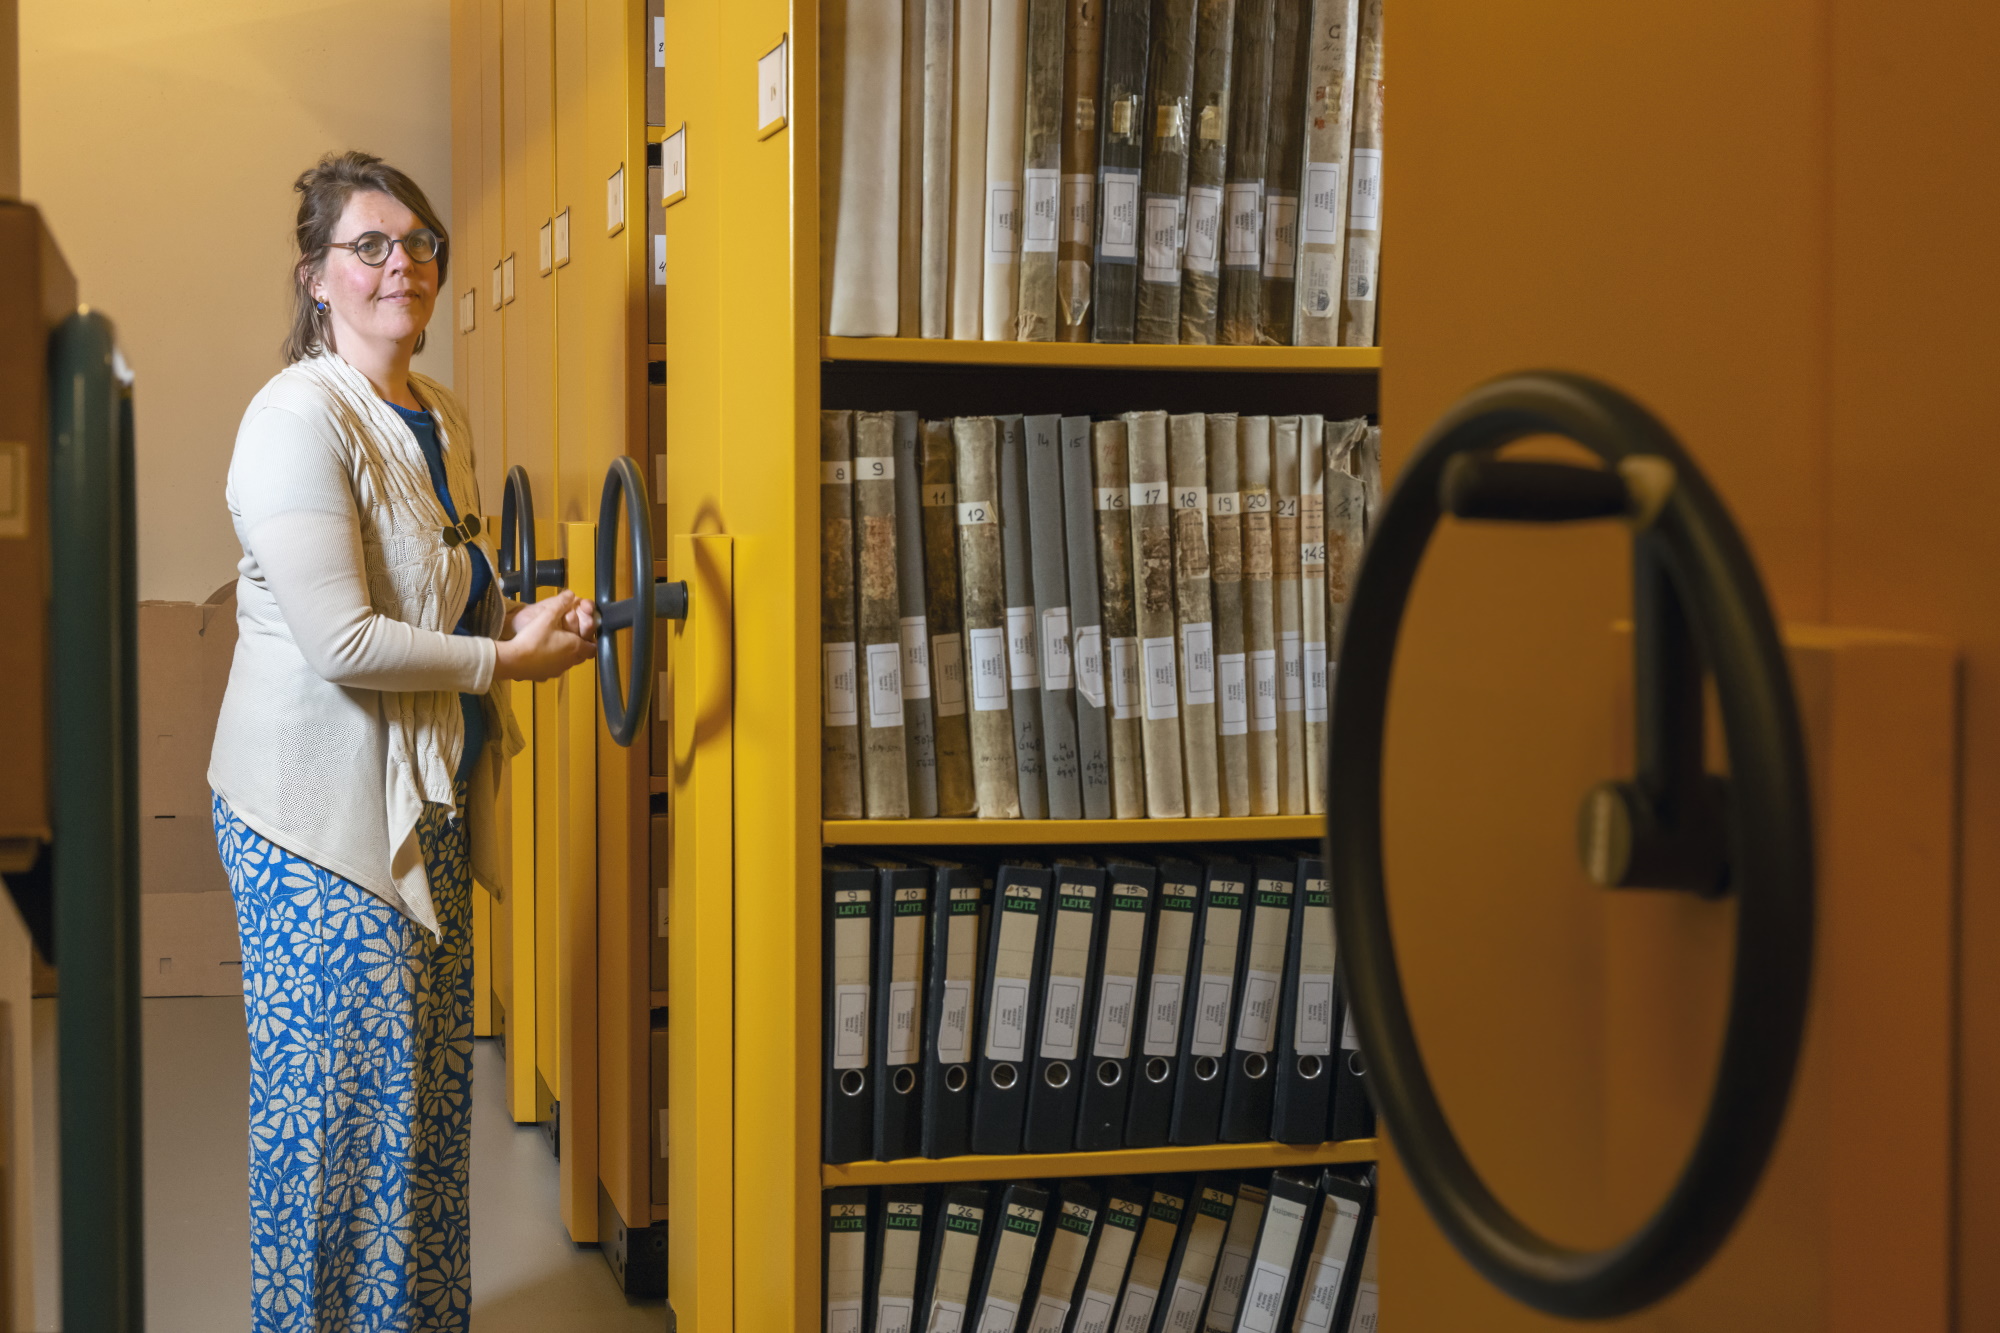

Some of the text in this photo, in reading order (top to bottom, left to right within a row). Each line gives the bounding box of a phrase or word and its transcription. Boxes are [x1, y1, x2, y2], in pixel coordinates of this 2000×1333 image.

[1037, 432, 1049, 447] 14
[1069, 436, 1085, 448] 15
[836, 468, 845, 480] 8
[872, 462, 884, 476] 9
[932, 491, 946, 505] 11
[1106, 494, 1124, 510] 16
[1144, 489, 1161, 505] 17
[1180, 492, 1198, 508] 18
[1247, 494, 1267, 510] 20
[1218, 496, 1232, 512] 19
[1276, 500, 1295, 516] 21
[968, 508, 985, 522] 12
[1014, 887, 1031, 898] 13
[1071, 886, 1084, 896] 14
[1126, 886, 1138, 895] 15
[1173, 886, 1185, 896] 16
[1221, 883, 1234, 893] 17
[1270, 882, 1283, 892] 18
[848, 891, 858, 902] 9
[904, 890, 918, 900] 10
[958, 890, 968, 899] 11
[1212, 894, 1239, 906] LEITZ
[1260, 894, 1288, 905] LEITZ
[1309, 894, 1330, 904] LEIT
[898, 902, 923, 913] LEITZ
[952, 902, 976, 912] LEITZ
[1007, 898, 1036, 910] LEITZ
[1062, 898, 1092, 909] LEITZ
[1114, 898, 1142, 909] LEITZ
[1164, 898, 1192, 908] LEITZ
[839, 904, 867, 915] LEITZ
[1161, 1196, 1177, 1208] 30
[1212, 1191, 1225, 1203] 31
[840, 1205, 856, 1216] 24
[898, 1204, 916, 1214] 25
[958, 1207, 972, 1218] 26
[1017, 1207, 1034, 1220] 27
[1072, 1206, 1090, 1218] 28
[1118, 1202, 1134, 1214] 29
[1152, 1206, 1178, 1220] LEITZ
[1200, 1202, 1227, 1217] LEITZ
[834, 1218, 863, 1229] LEITZ
[889, 1216, 918, 1228] LEITZ
[948, 1219, 978, 1232] LEITZ
[1062, 1216, 1090, 1232] LEITZ
[1109, 1212, 1136, 1227] LEITZ
[1008, 1219, 1036, 1234] LEITZ
